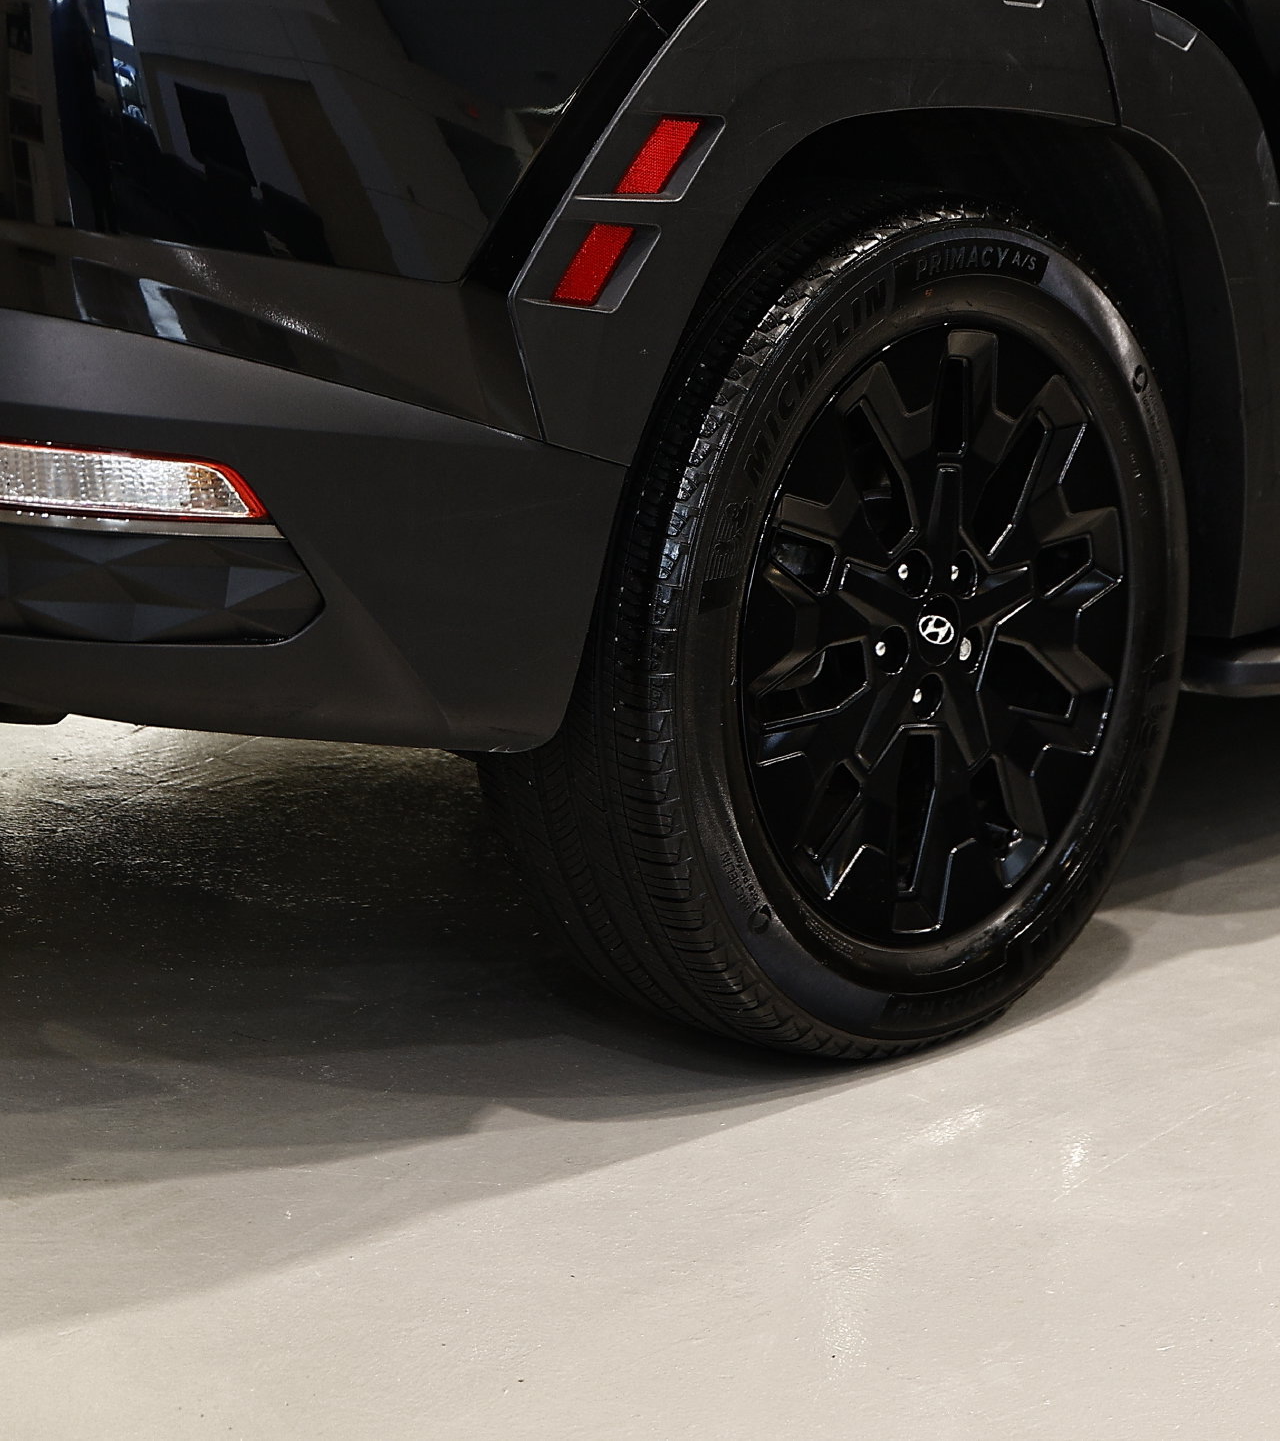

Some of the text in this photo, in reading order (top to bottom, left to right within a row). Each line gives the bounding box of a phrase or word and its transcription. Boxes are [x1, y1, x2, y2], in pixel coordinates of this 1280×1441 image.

[742, 243, 1038, 487] MICHELIN PRIMACY A/S
